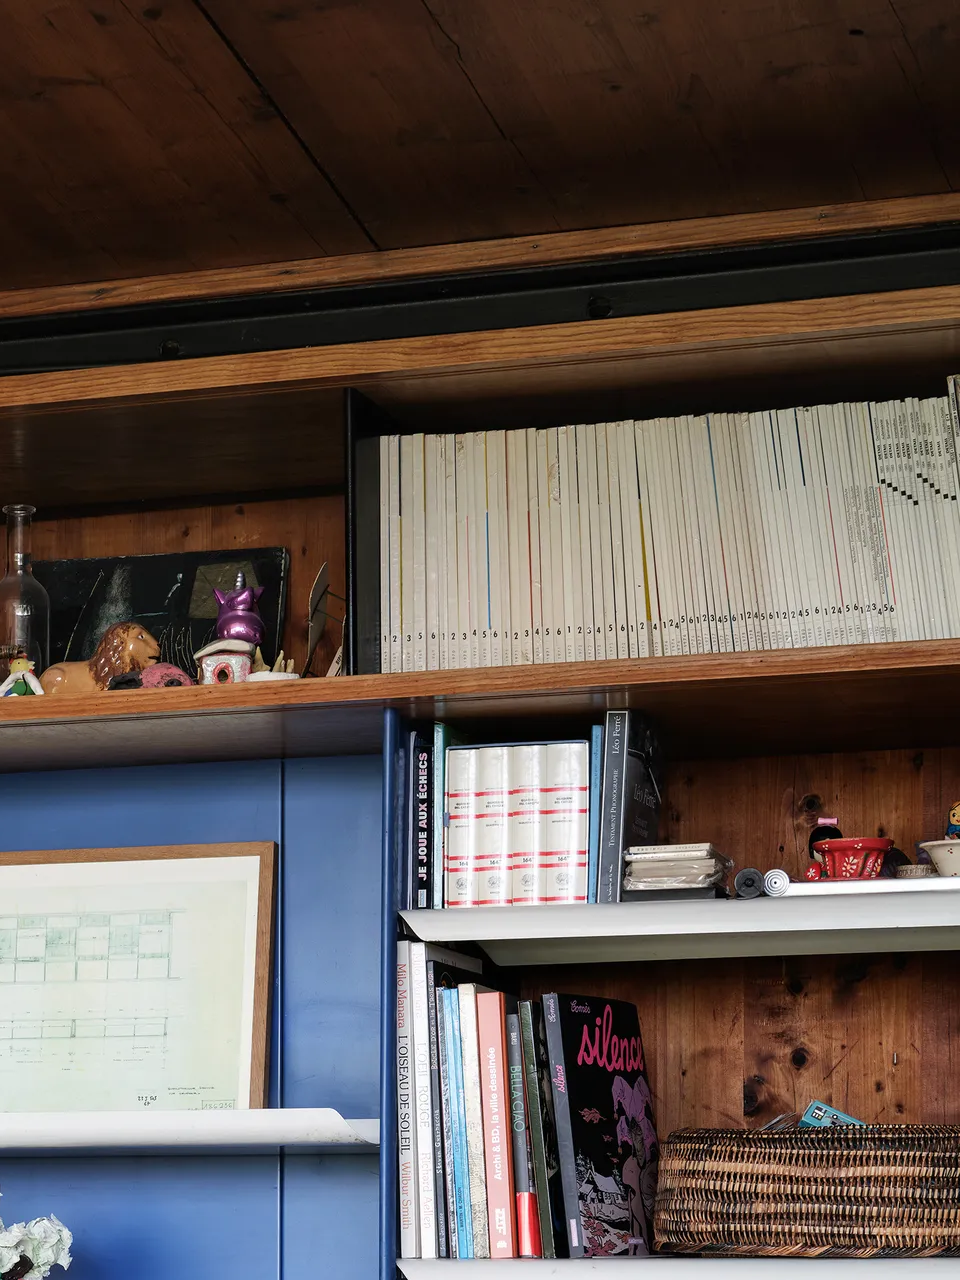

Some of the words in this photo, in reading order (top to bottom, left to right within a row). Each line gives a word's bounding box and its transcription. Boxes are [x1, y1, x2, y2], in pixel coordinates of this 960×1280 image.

[613, 715, 622, 736] Ferré
[612, 738, 621, 754] Léo
[417, 752, 428, 798] ÉCHECS
[419, 802, 427, 827] AUX
[418, 831, 427, 862] JOUE
[418, 866, 427, 880] JE
[396, 963, 406, 986] Milo
[397, 989, 407, 1028] Manara
[546, 998, 556, 1023] Comès
[570, 1000, 591, 1014] Comès
[577, 1004, 644, 1072] silence
[398, 1035, 408, 1090] L'OISEAU
[486, 1046, 499, 1091] dessinée
[509, 1064, 524, 1098] BELLA
[552, 1064, 566, 1092] silence
[399, 1093, 409, 1109] DE
[418, 1085, 429, 1128] ROUGE
[490, 1093, 499, 1112] ville
[511, 1100, 525, 1131] CIAO
[399, 1112, 410, 1154] SOLEIL
[491, 1114, 500, 1123] la
[492, 1125, 502, 1142] BD,
[400, 1161, 410, 1196] Wilbur
[420, 1152, 431, 1192] Richard
[492, 1154, 502, 1180] Archi
[401, 1199, 411, 1229] Smith
[422, 1196, 432, 1228] Aellen
